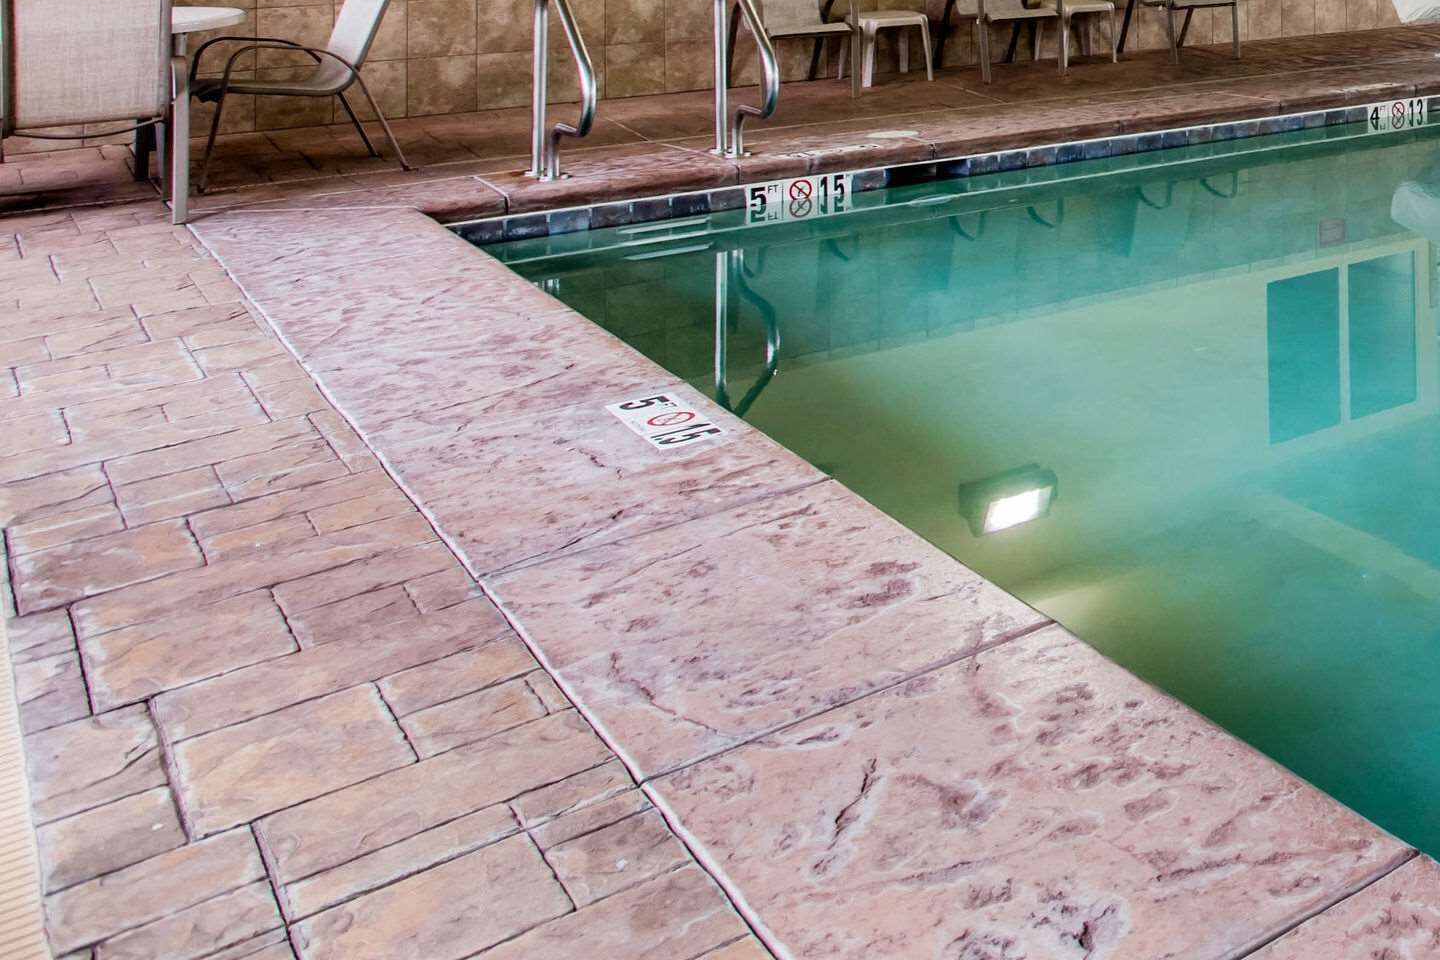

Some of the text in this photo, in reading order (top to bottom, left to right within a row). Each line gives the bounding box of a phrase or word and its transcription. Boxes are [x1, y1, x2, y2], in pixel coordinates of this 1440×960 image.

[1370, 106, 1380, 121] 4
[750, 186, 767, 205] 5
[767, 184, 779, 194] FT
[619, 395, 670, 410] 5
